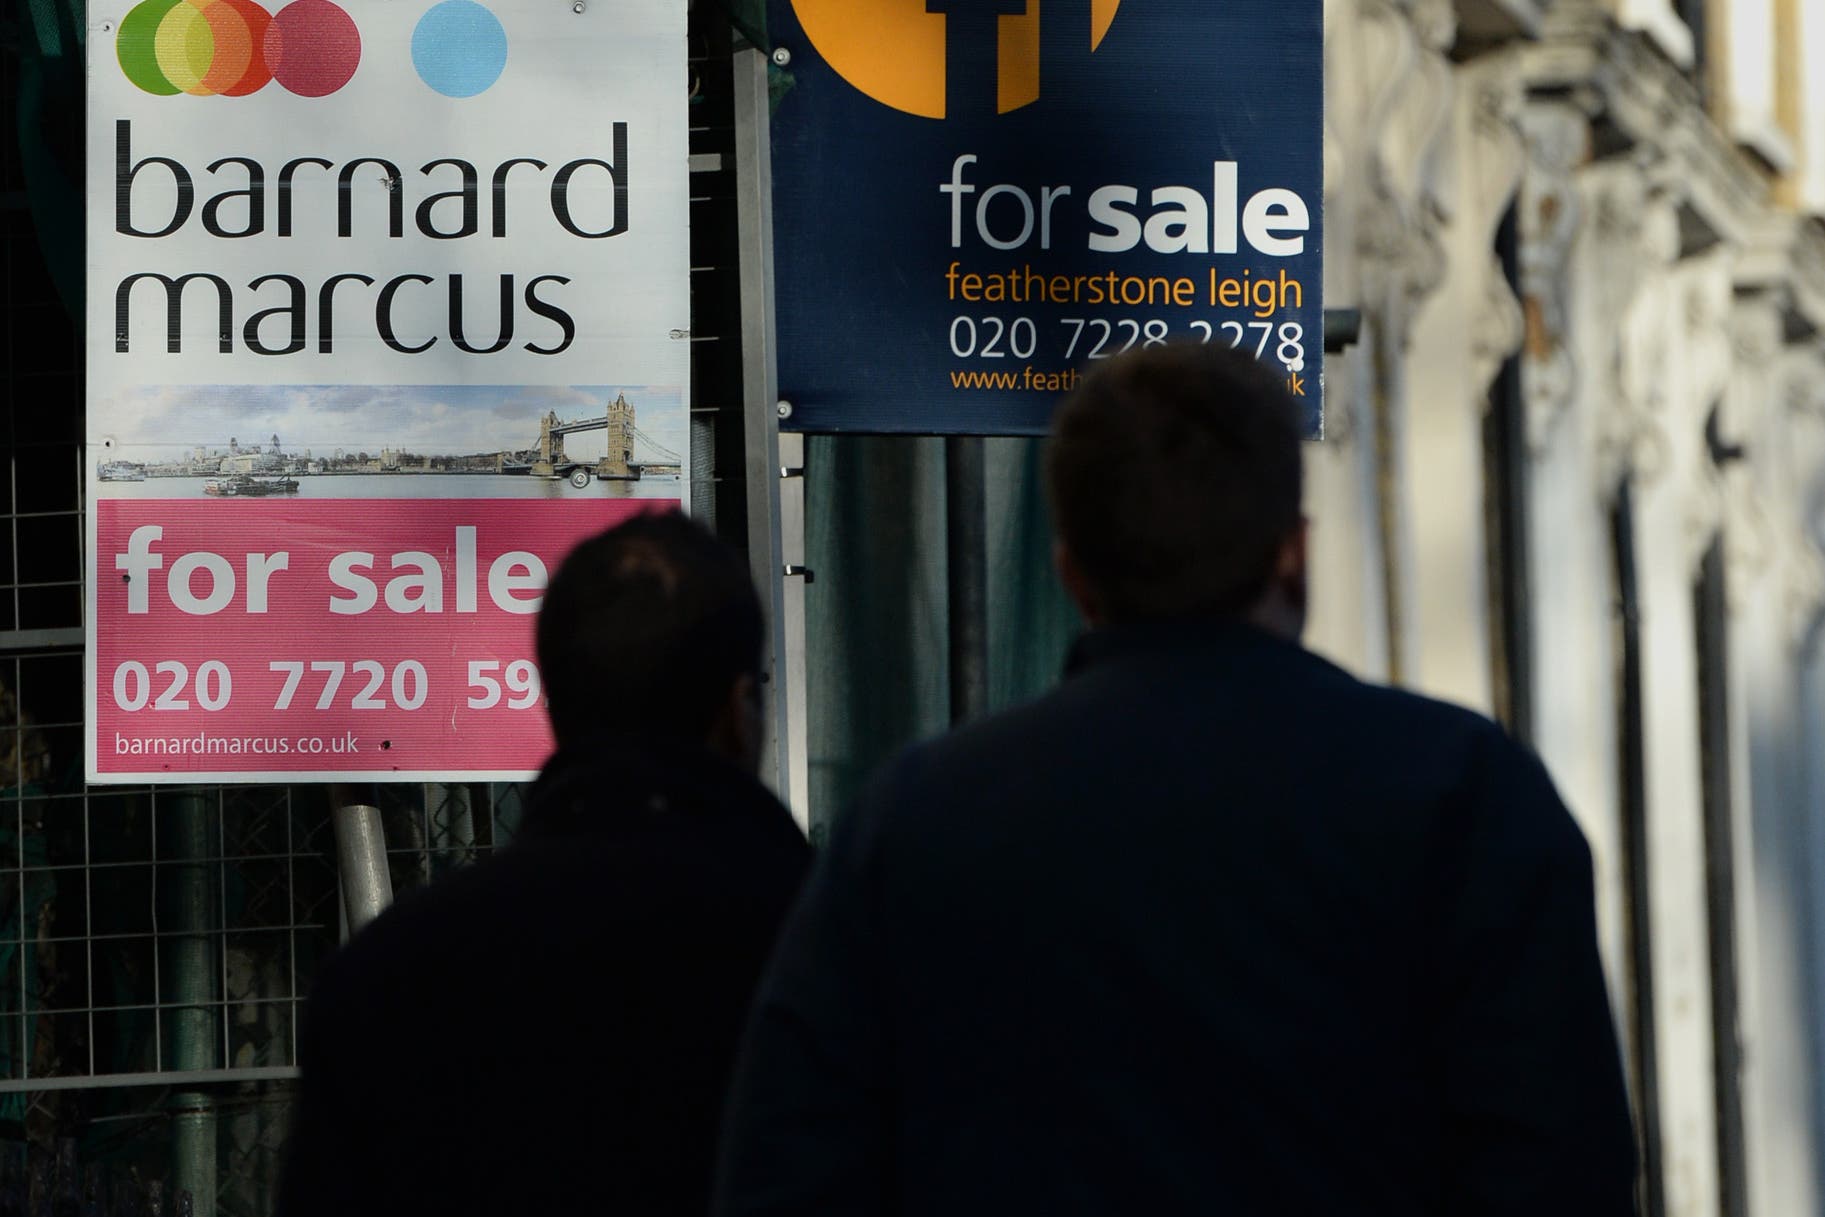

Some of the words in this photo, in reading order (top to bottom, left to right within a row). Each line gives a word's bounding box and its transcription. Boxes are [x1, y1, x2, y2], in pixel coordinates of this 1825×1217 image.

[115, 119, 629, 240] barnard
[940, 153, 1071, 250] for
[1088, 160, 1310, 257] sale
[115, 272, 576, 356] marcus
[945, 261, 1195, 307] featherstone
[1209, 267, 1303, 318] leigh
[949, 315, 1037, 359] 020
[1060, 318, 1169, 360] 7228
[115, 524, 290, 616] for
[328, 525, 549, 615] sale
[112, 659, 233, 712] 020
[269, 659, 429, 711] 7720
[467, 659, 548, 710] 59
[115, 730, 360, 755] barnardmarcus.co.uk
